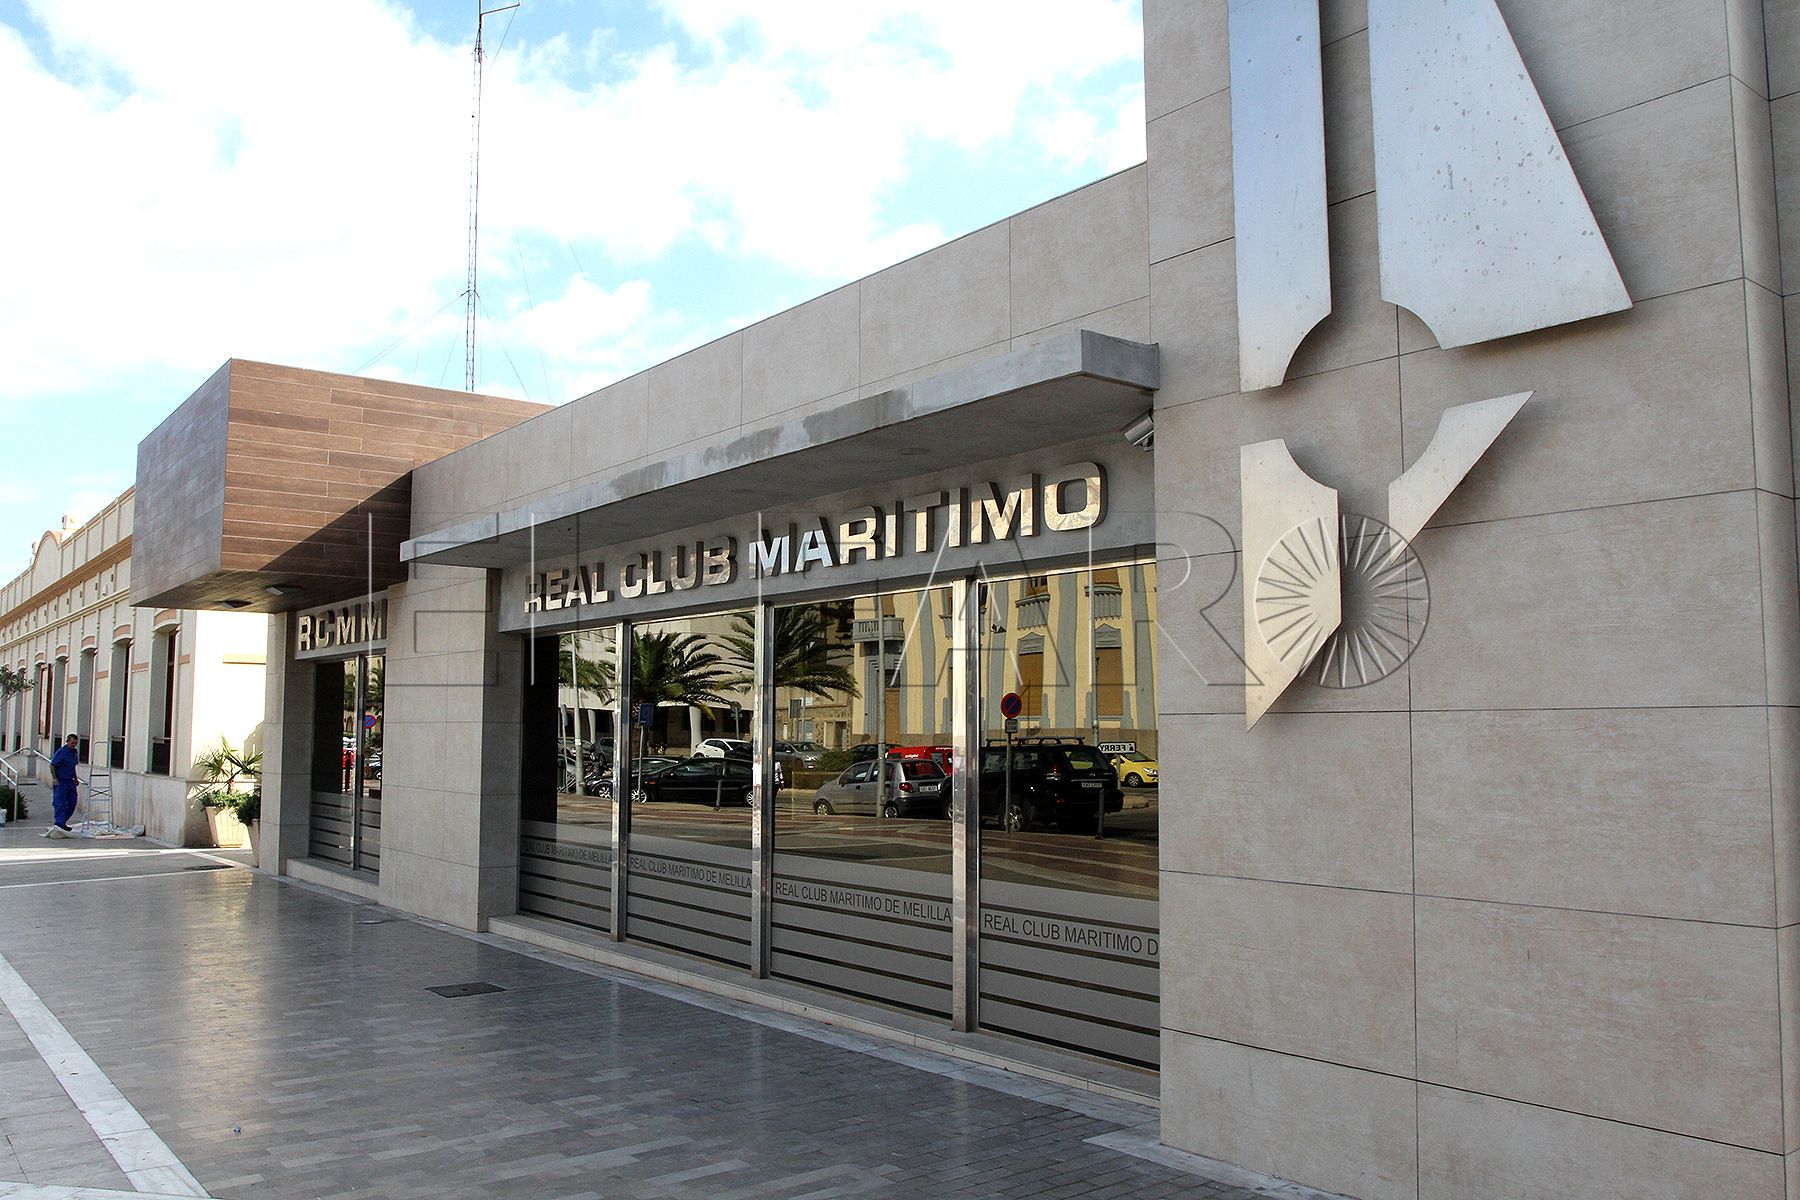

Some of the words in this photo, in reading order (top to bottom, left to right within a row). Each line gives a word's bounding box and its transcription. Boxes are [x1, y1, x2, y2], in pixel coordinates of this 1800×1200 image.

[524, 561, 613, 613] REAL
[619, 535, 738, 599] CLUB
[749, 461, 1109, 579] MARITIMO
[298, 598, 388, 652] RCMM
[629, 857, 647, 870] REAL
[648, 860, 667, 874] CLUB
[668, 864, 705, 880] MARITIMO
[706, 870, 717, 883] DE
[719, 873, 752, 889] MELILLA
[775, 881, 799, 898] REAL
[801, 885, 828, 902] CLUB
[830, 890, 882, 911] MARITIMO
[885, 898, 900, 914] DE
[903, 901, 952, 922] MELILLA
[984, 913, 1018, 934] REAL
[1022, 919, 1060, 940] CLUB
[1065, 926, 1142, 953] MARITIMO
